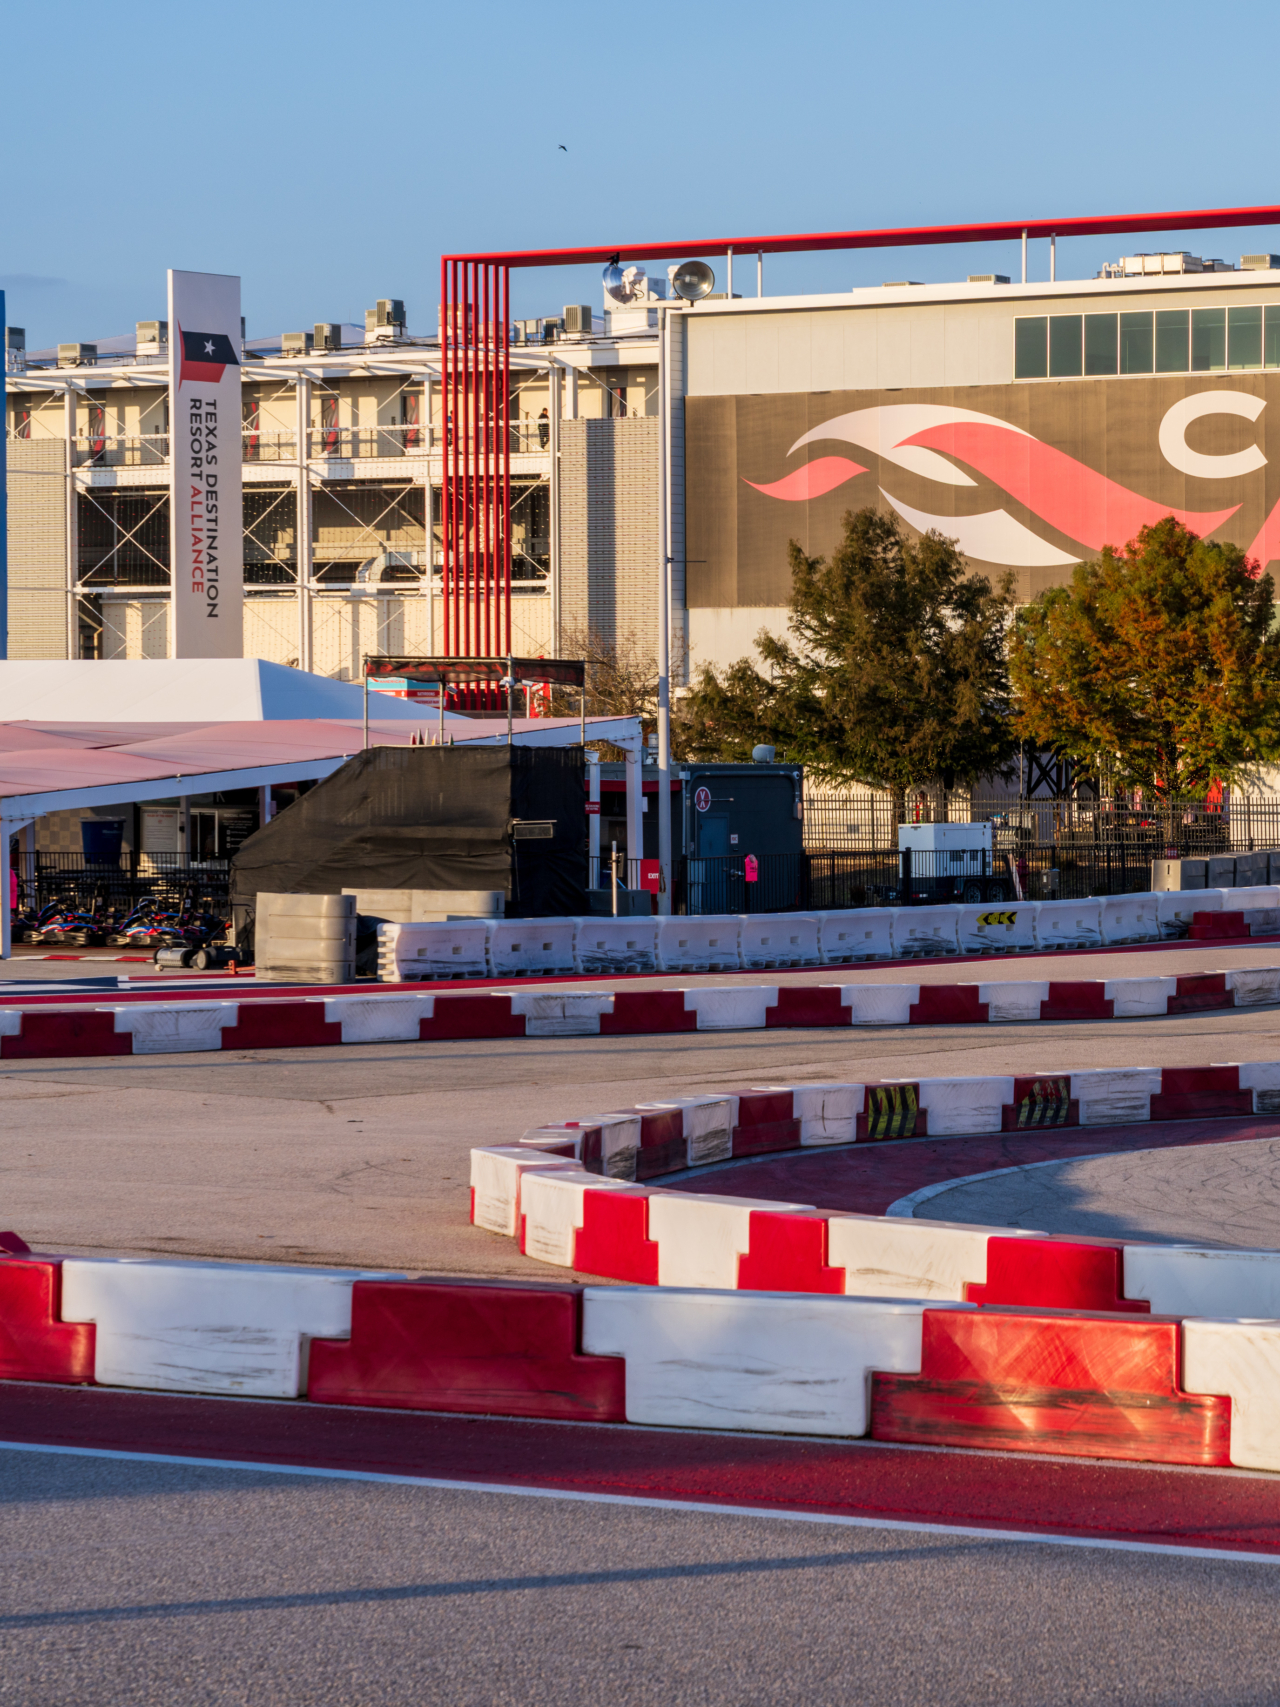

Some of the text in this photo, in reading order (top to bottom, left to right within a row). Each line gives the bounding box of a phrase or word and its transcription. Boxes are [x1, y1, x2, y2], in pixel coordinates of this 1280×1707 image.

[189, 397, 205, 594] RESORT ALLIANCE
[204, 398, 219, 618] TEXAS DESTINATION
